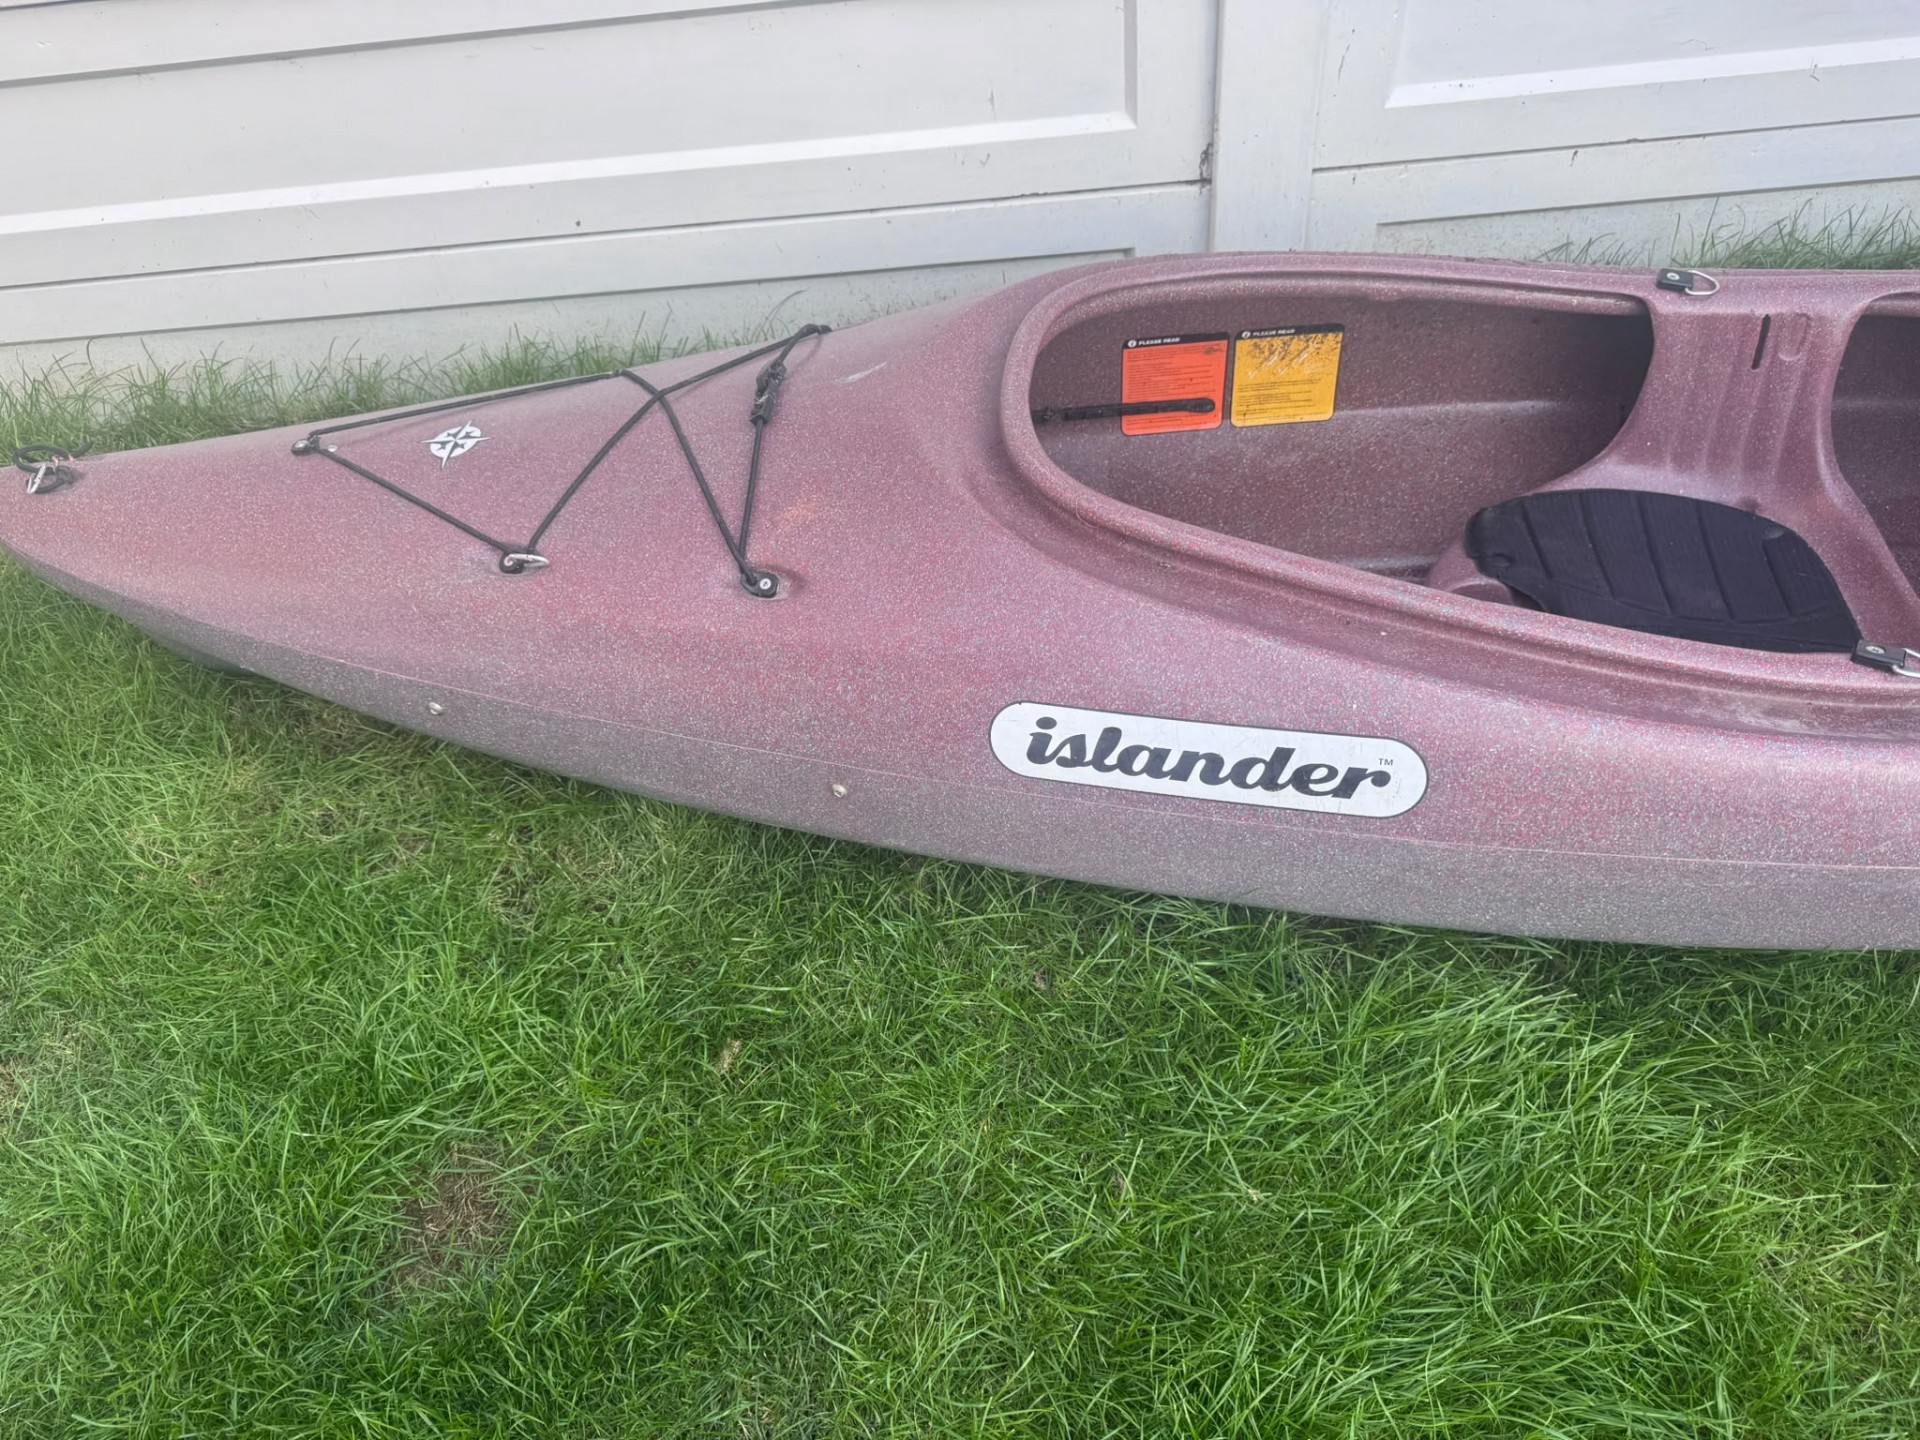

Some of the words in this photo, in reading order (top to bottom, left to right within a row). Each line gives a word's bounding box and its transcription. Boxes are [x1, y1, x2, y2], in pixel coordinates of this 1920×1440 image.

[1138, 338, 1161, 346] PLEASE
[1027, 716, 1391, 799] islander
[1378, 757, 1394, 766] TM
